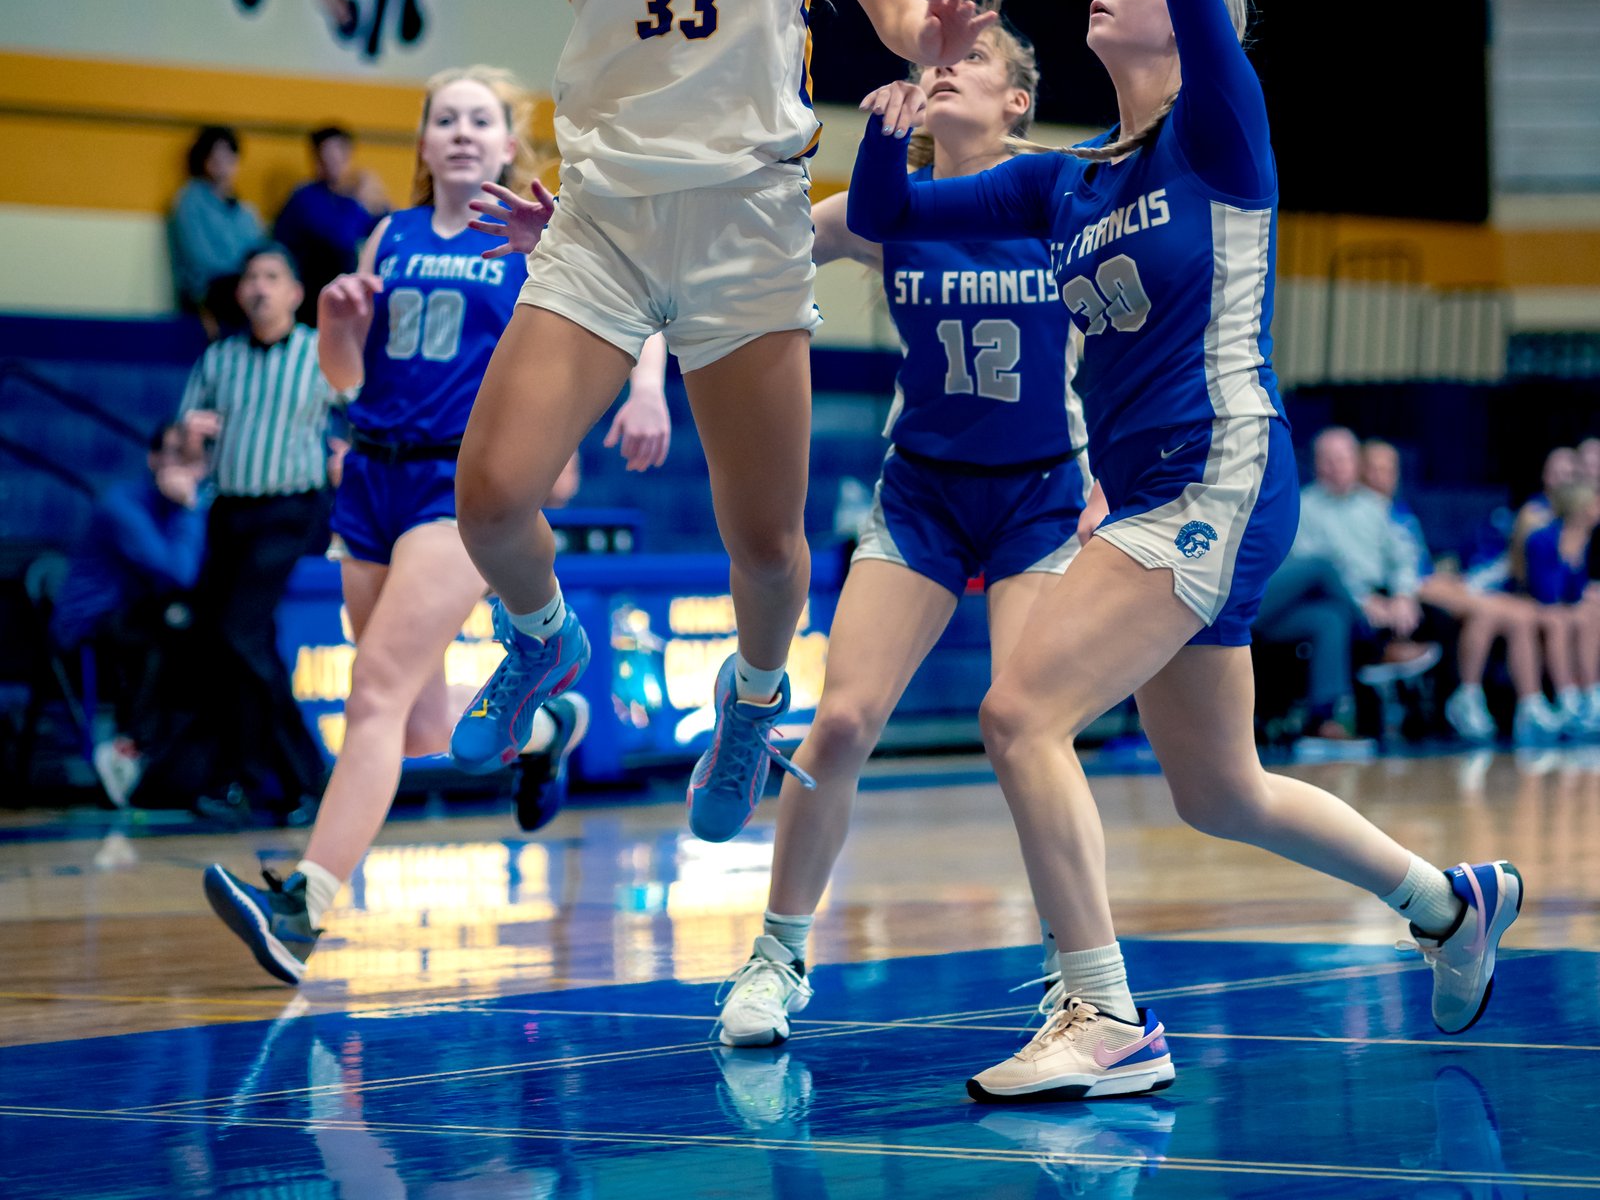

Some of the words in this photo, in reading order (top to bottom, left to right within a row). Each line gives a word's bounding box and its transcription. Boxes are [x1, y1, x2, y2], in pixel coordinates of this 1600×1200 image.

[404, 253, 506, 286] FRANCIS
[895, 270, 932, 305] ST.
[942, 269, 1060, 305] FRANCIS
[936, 319, 1020, 402] 12
